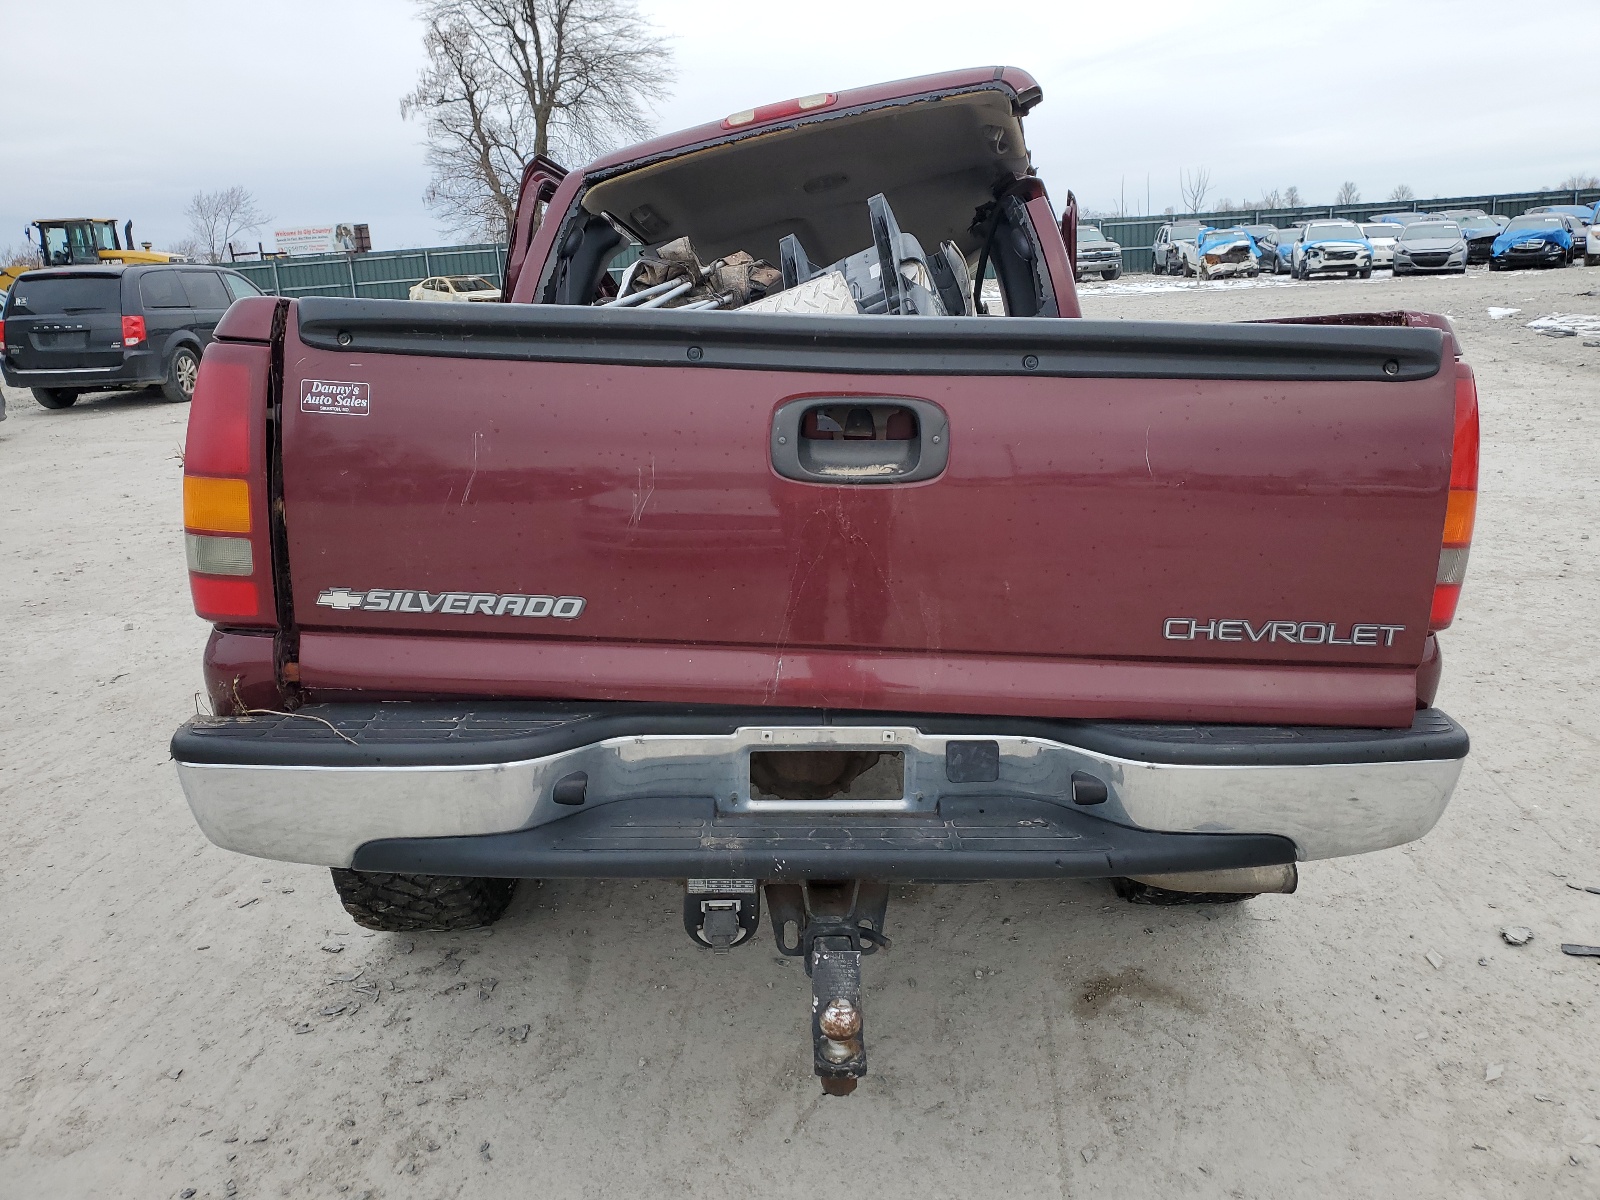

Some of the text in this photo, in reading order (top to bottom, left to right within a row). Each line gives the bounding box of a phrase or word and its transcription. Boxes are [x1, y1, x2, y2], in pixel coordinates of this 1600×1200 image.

[303, 393, 368, 407] Auto Sales
[311, 381, 360, 397] Danny's
[362, 588, 587, 620] SILVERADO
[1163, 617, 1406, 648] CHEVROLET
